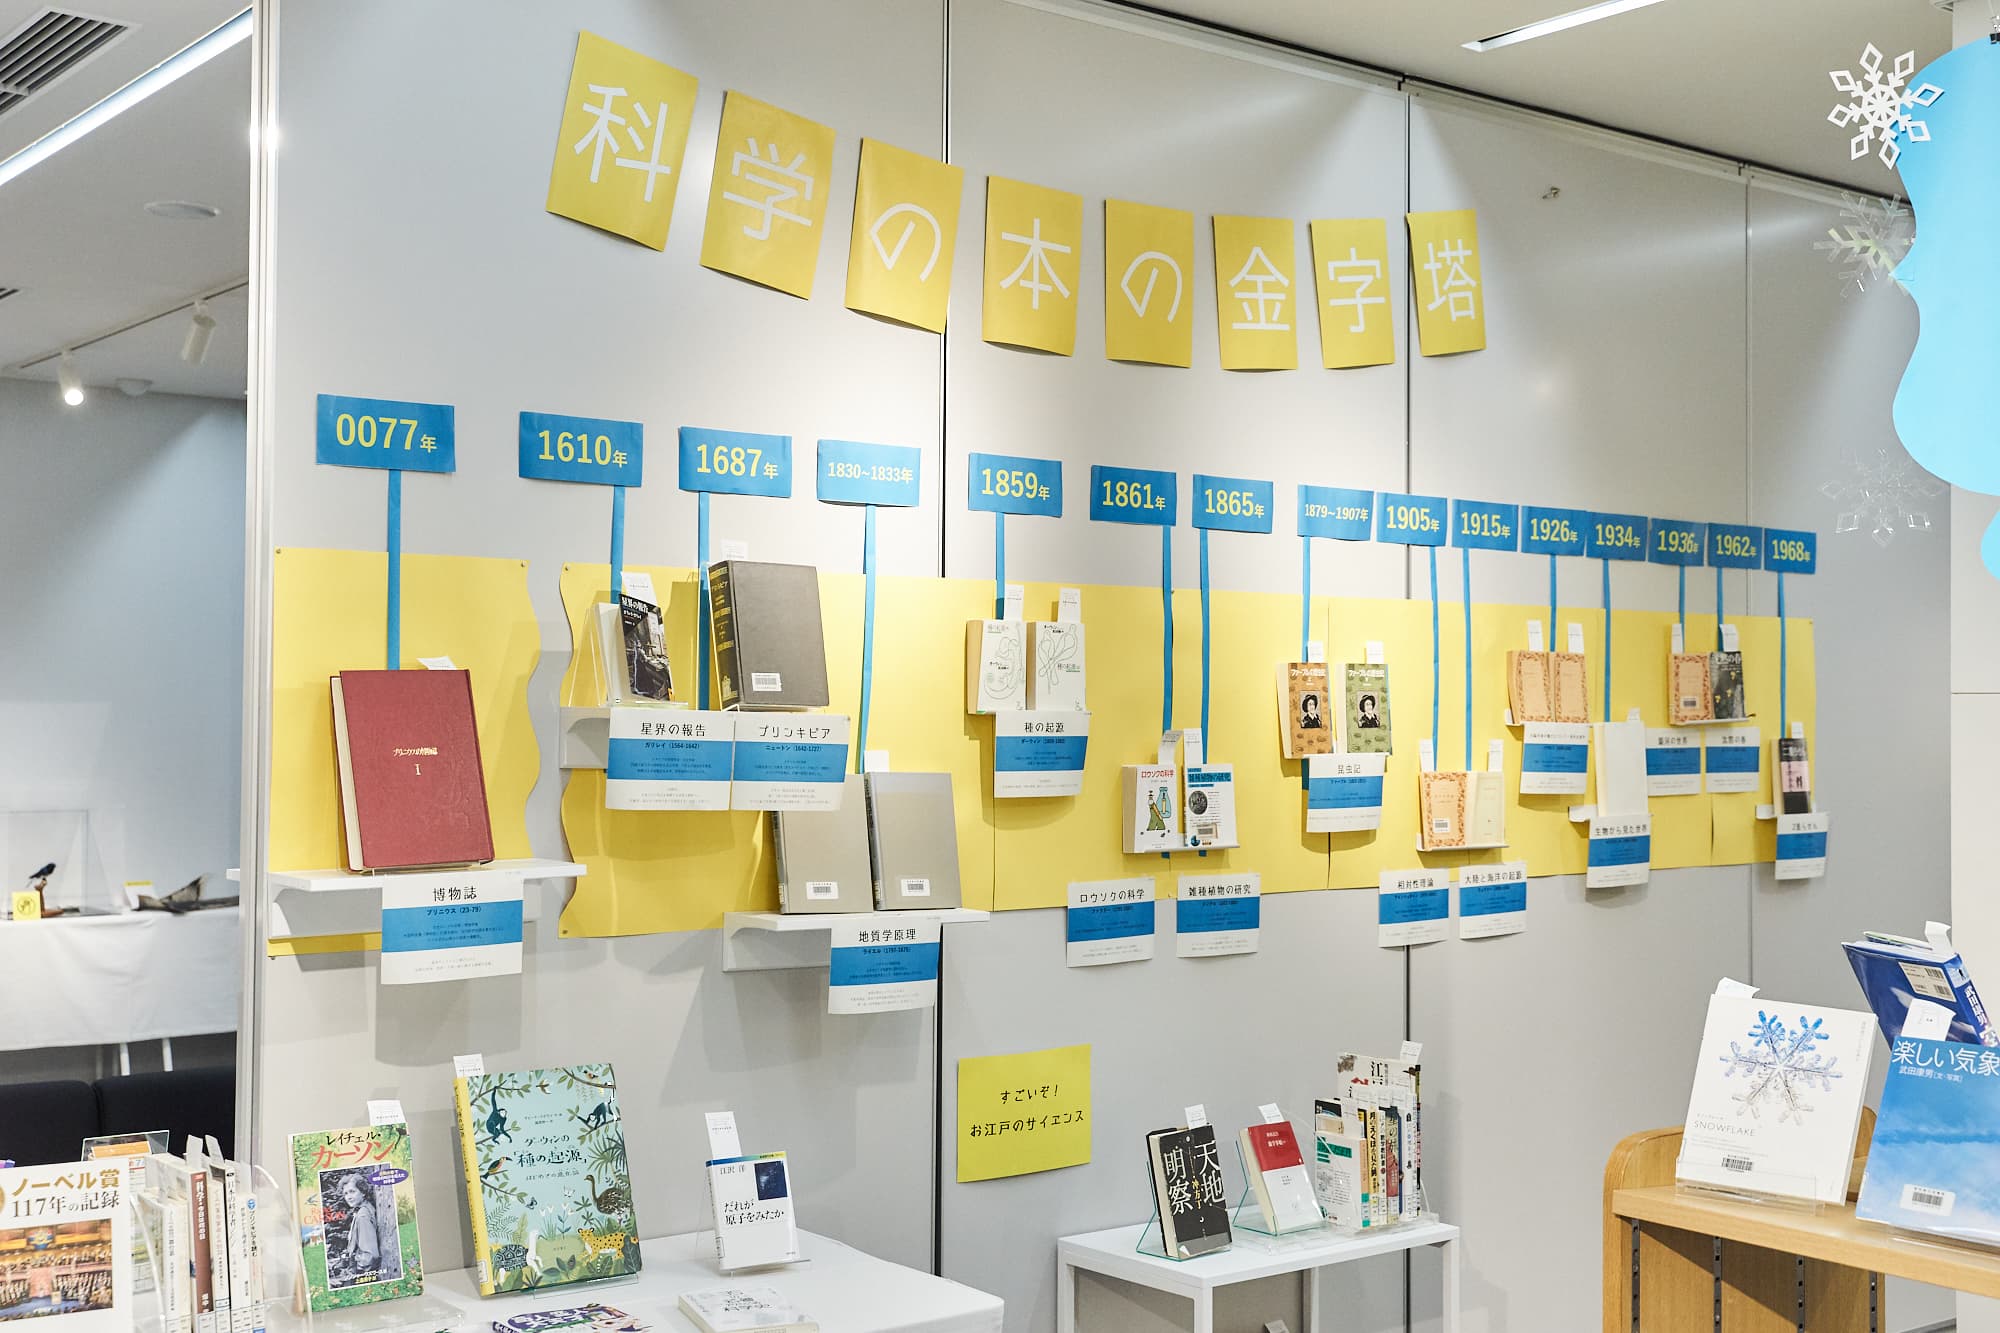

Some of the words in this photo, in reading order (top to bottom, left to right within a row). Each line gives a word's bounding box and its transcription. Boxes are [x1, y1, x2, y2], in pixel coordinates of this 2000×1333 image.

[574, 83, 1477, 333] 科学の本の金字塔
[336, 412, 437, 453] 0077年
[537, 430, 628, 468] 1610年
[697, 443, 779, 480] 1687年
[981, 468, 1050, 501] 1859年
[1102, 480, 1166, 511] 1861年
[1204, 489, 1265, 519] 1865年
[1386, 504, 1440, 533] 1905年
[1460, 511, 1511, 539] 1915年
[1530, 517, 1578, 544] 1926年
[1595, 523, 1641, 549] 1934年
[1657, 528, 1699, 554] 1936年
[1715, 533, 1757, 558] 1962年
[1771, 538, 1811, 563] 1968年
[641, 722, 706, 737] 星界の報告
[759, 725, 831, 739] プリンキピア
[1024, 722, 1065, 733] 種の起源
[433, 886, 477, 901] 博物誌
[1080, 888, 1145, 903] ロウソクの科学
[1188, 884, 1251, 897] 雑種植物の研究
[1398, 878, 1434, 890] 相対性理論
[859, 928, 917, 943] 地質学原理
[1892, 1040, 2000, 1077] 楽しい気象
[970, 1110, 1084, 1137] お江戸のサイエンス
[311, 1141, 395, 1169] カーソン
[12, 1168, 120, 1197] ノーベル賞
[12, 1189, 120, 1218] 117年の記録
[724, 1199, 754, 1213] だれが
[725, 1209, 785, 1225] 原子をみたか
